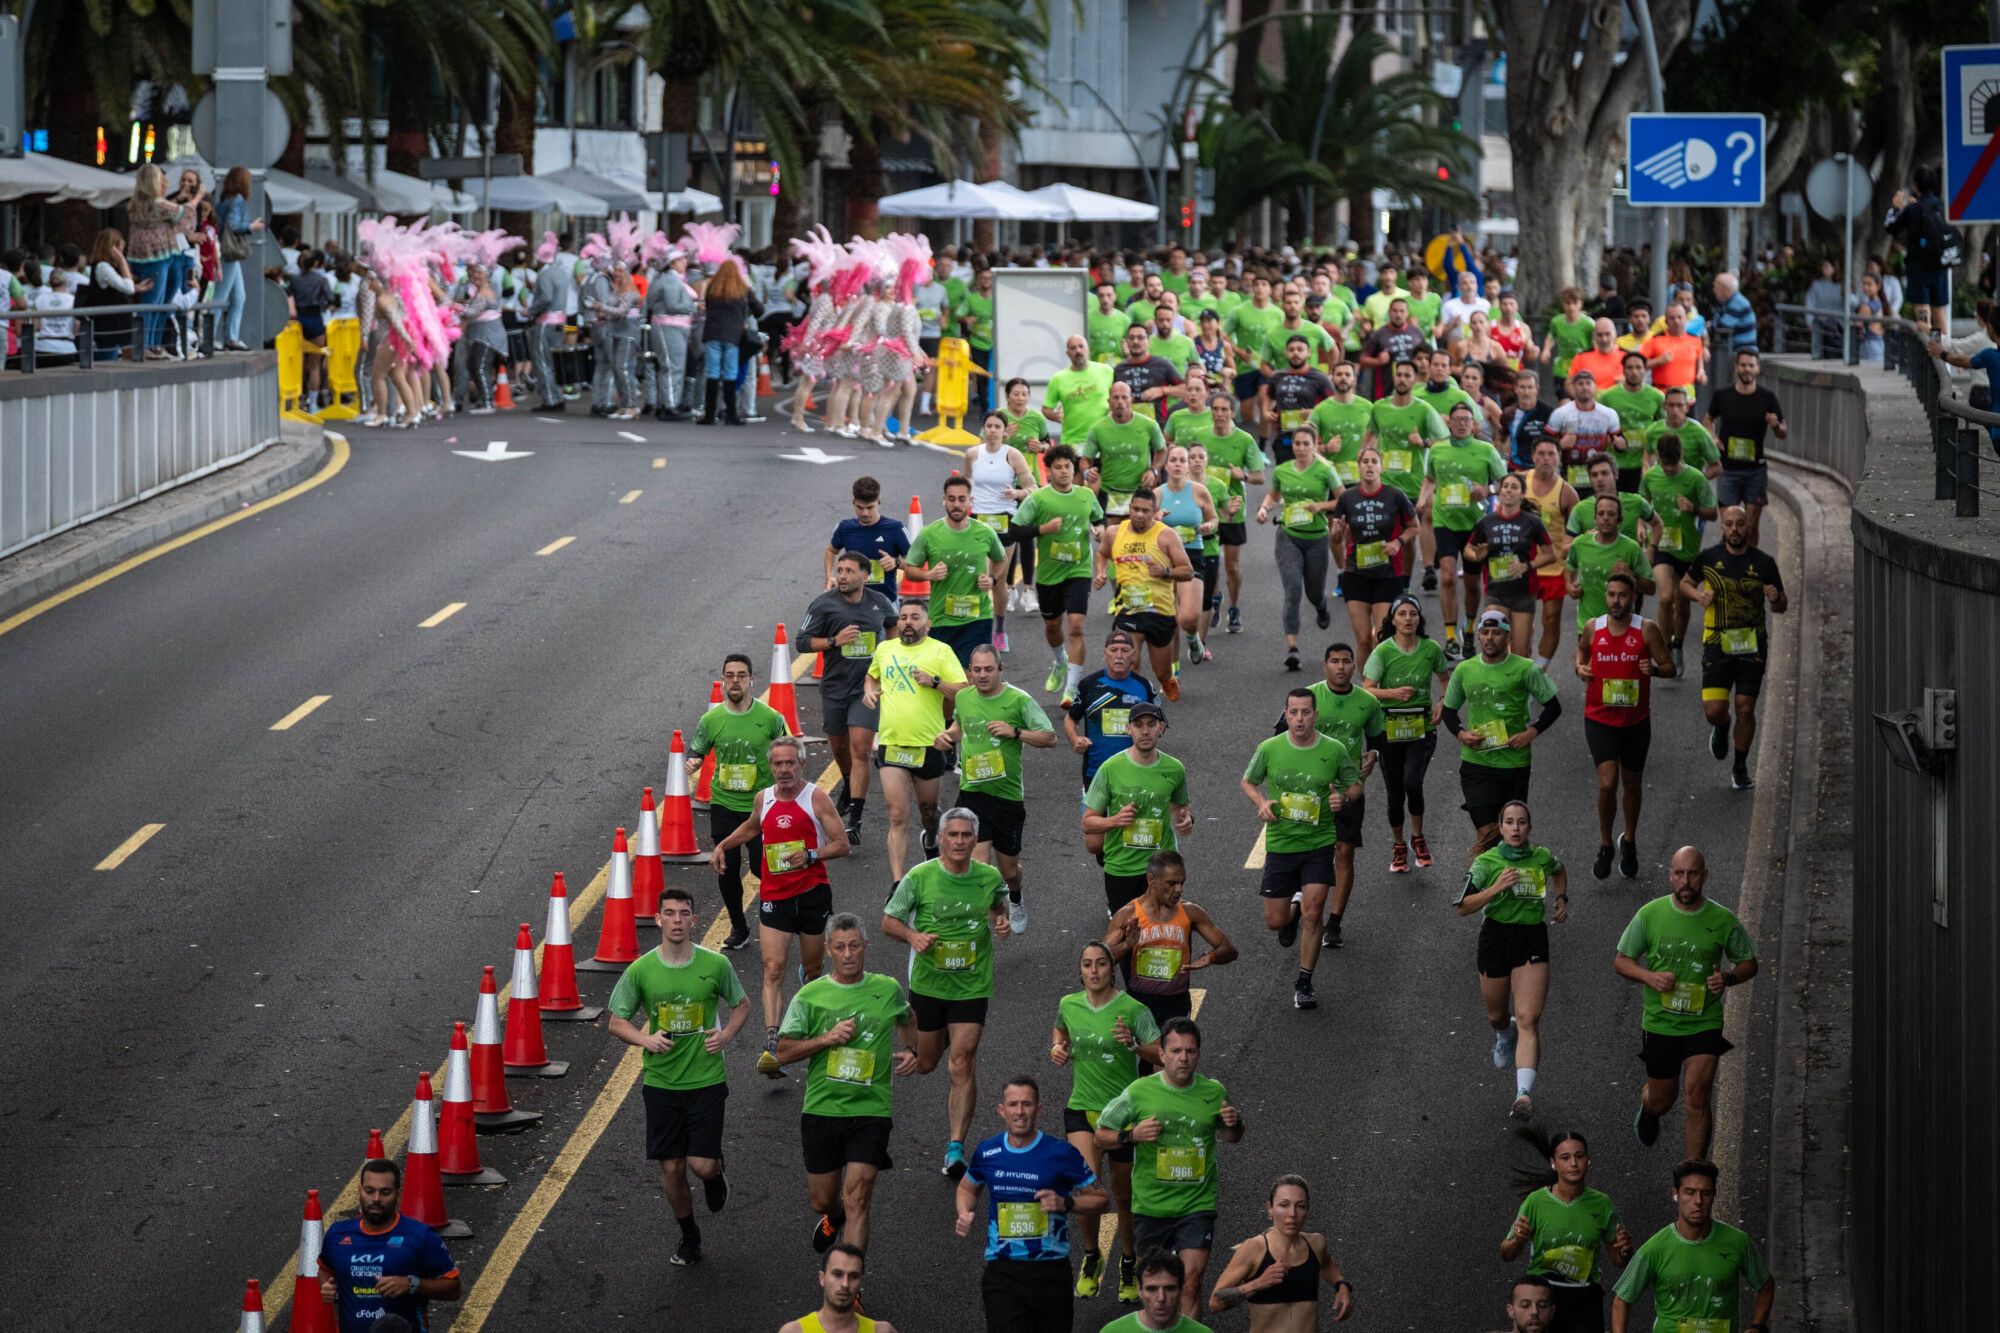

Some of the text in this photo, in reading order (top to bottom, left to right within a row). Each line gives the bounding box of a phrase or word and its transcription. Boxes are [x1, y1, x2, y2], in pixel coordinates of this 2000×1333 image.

[1725, 131, 1756, 187] ?
[1354, 500, 1384, 509] TEAM
[1491, 524, 1521, 532] TEAM
[1597, 652, 1618, 662] Santa
[896, 752, 913, 762] 7754
[976, 767, 994, 777] 5391
[728, 780, 747, 788] 5926
[1289, 808, 1309, 819] 7609
[1132, 834, 1153, 844] 6240
[945, 957, 966, 967] 8493
[1147, 965, 1168, 976] 7230
[1671, 999, 1690, 1010] 6471
[670, 1020, 691, 1030] 5473
[838, 1065, 861, 1078] 5472
[1006, 1171, 1039, 1181] HYUNDAI
[1169, 1166, 1193, 1178] 7966
[1010, 1221, 1034, 1233] 5536
[351, 1254, 385, 1263] KIA
